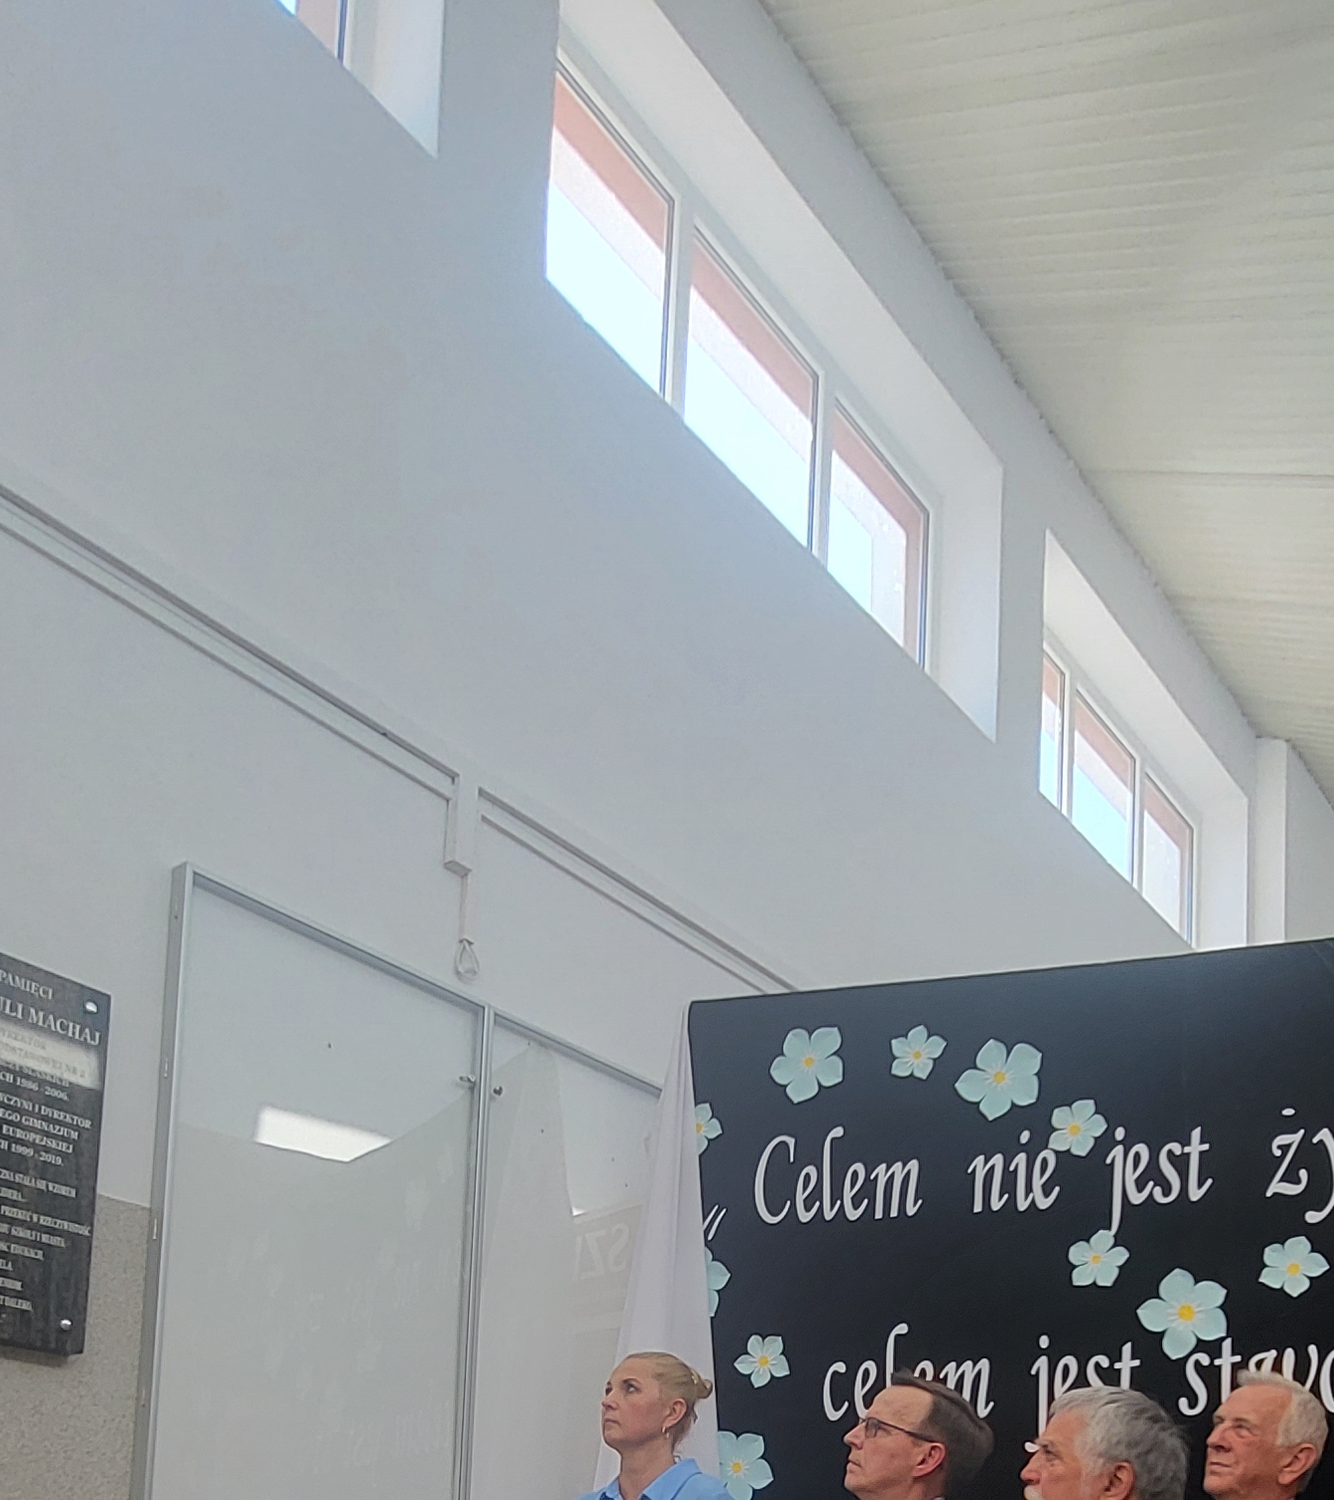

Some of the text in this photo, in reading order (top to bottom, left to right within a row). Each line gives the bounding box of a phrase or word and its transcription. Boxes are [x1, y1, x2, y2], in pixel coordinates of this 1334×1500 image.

[28, 1005, 101, 1047] MACHAJ
[21, 1114, 78, 1140] GIMNAZJUM
[40, 1103, 92, 1129] DYREKTOR
[1, 1123, 73, 1154] EUROPEJSKIEJ
[10, 1142, 34, 1157] 1999
[753, 1126, 923, 1225] Celem
[967, 1129, 1061, 1214] nie
[1105, 1126, 1213, 1235] jest
